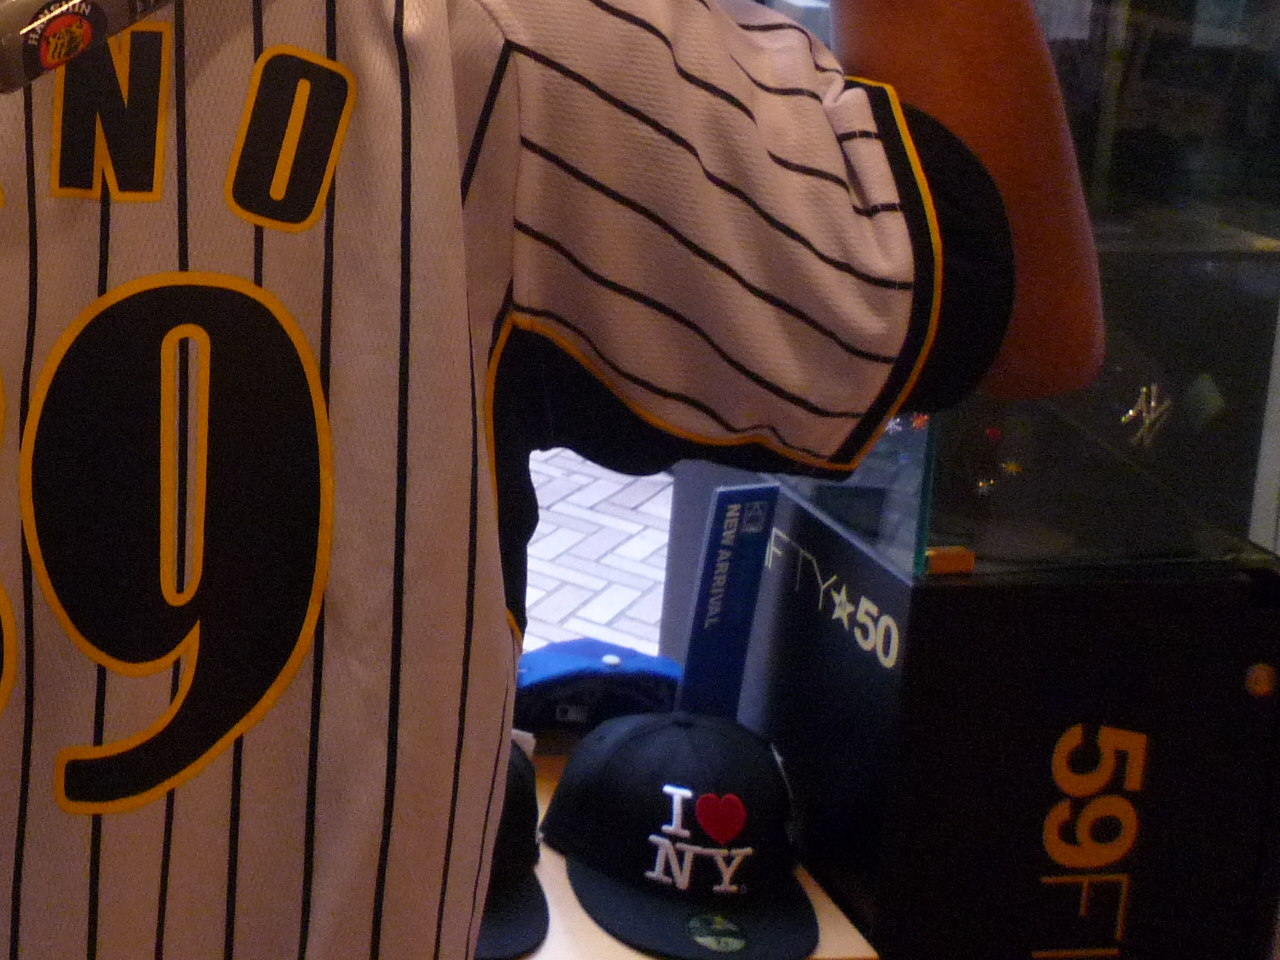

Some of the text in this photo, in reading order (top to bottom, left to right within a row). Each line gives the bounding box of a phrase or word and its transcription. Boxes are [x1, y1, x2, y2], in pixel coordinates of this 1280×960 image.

[704, 503, 742, 630] NEW ARRIVAL
[644, 834, 754, 894] NY
